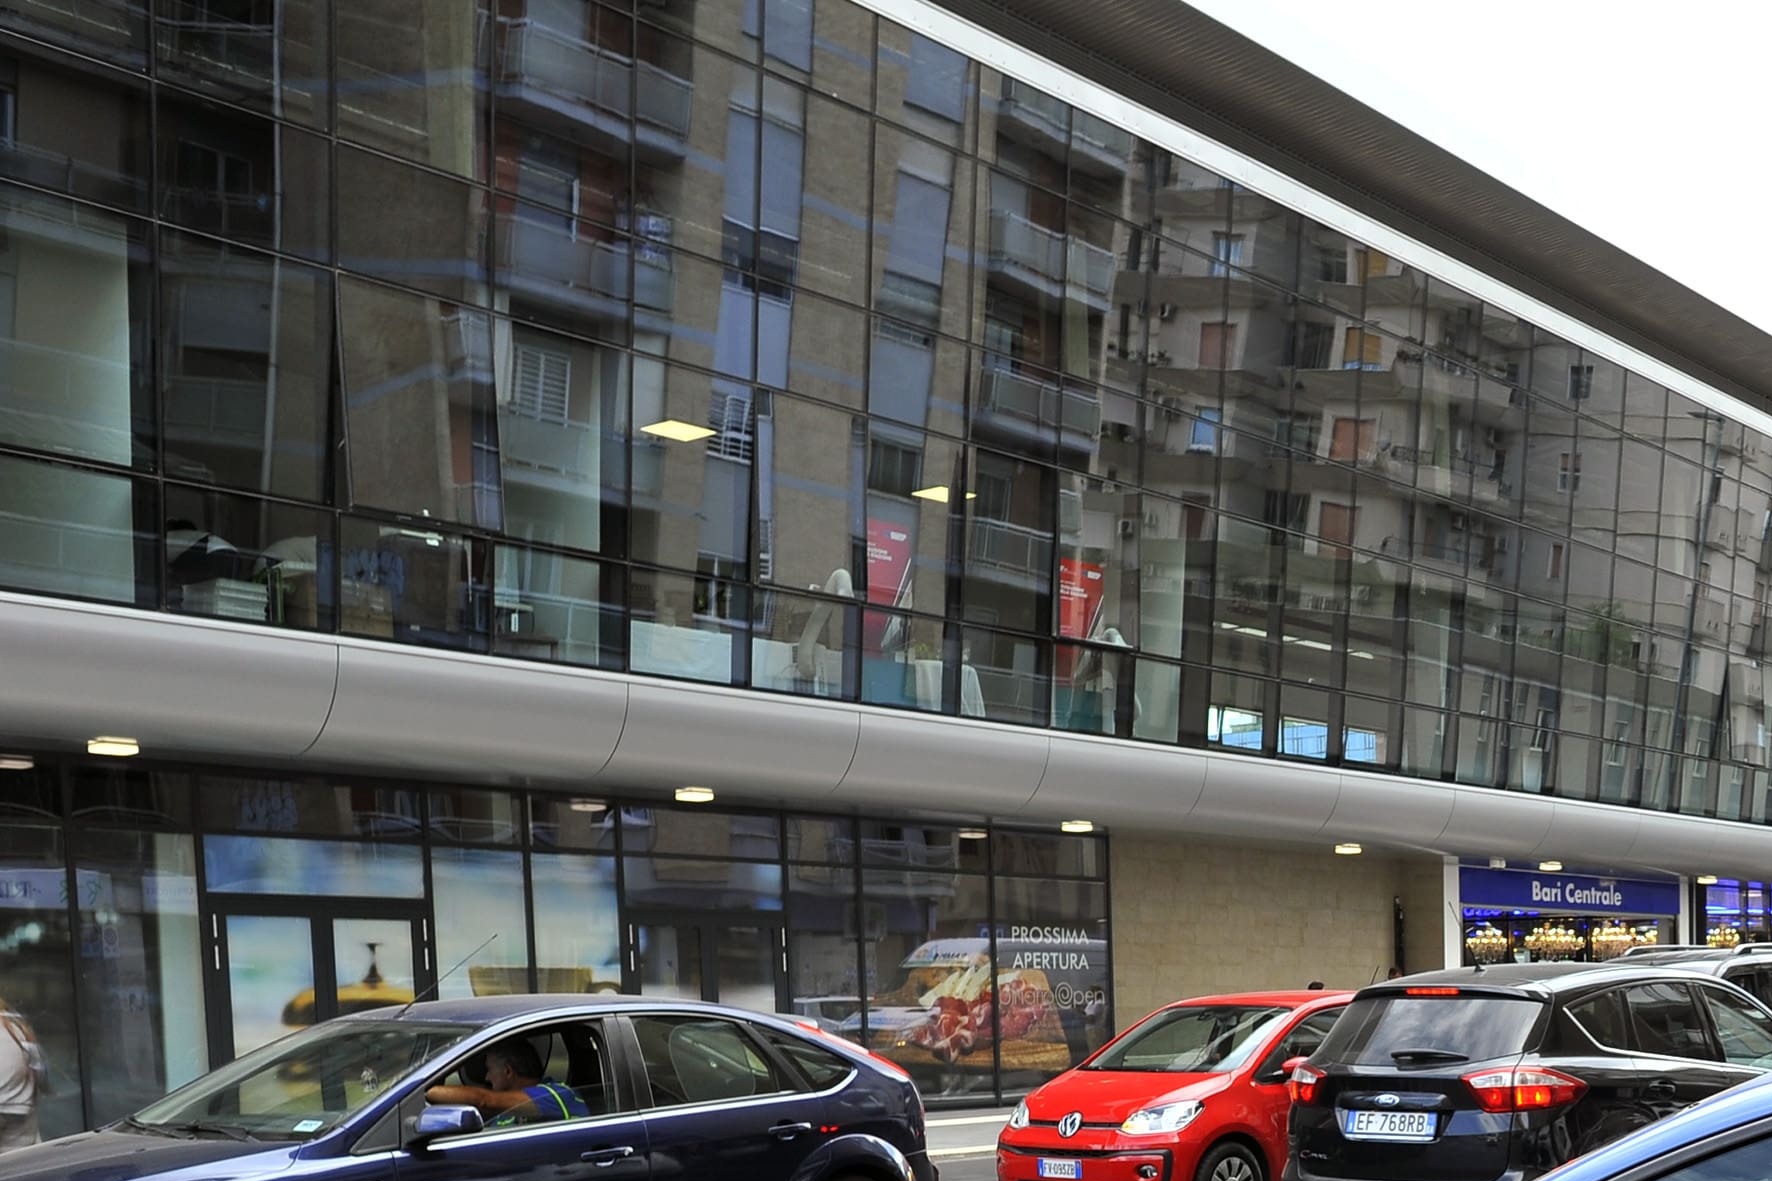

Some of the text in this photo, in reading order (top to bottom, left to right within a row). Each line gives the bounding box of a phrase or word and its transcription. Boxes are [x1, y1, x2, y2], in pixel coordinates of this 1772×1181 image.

[1532, 881, 1622, 906] Bari Centrale
[1011, 926, 1089, 945] PROSSIMA
[1013, 952, 1089, 970] APERTURA
[1356, 1112, 1426, 1133] EF 768RB
